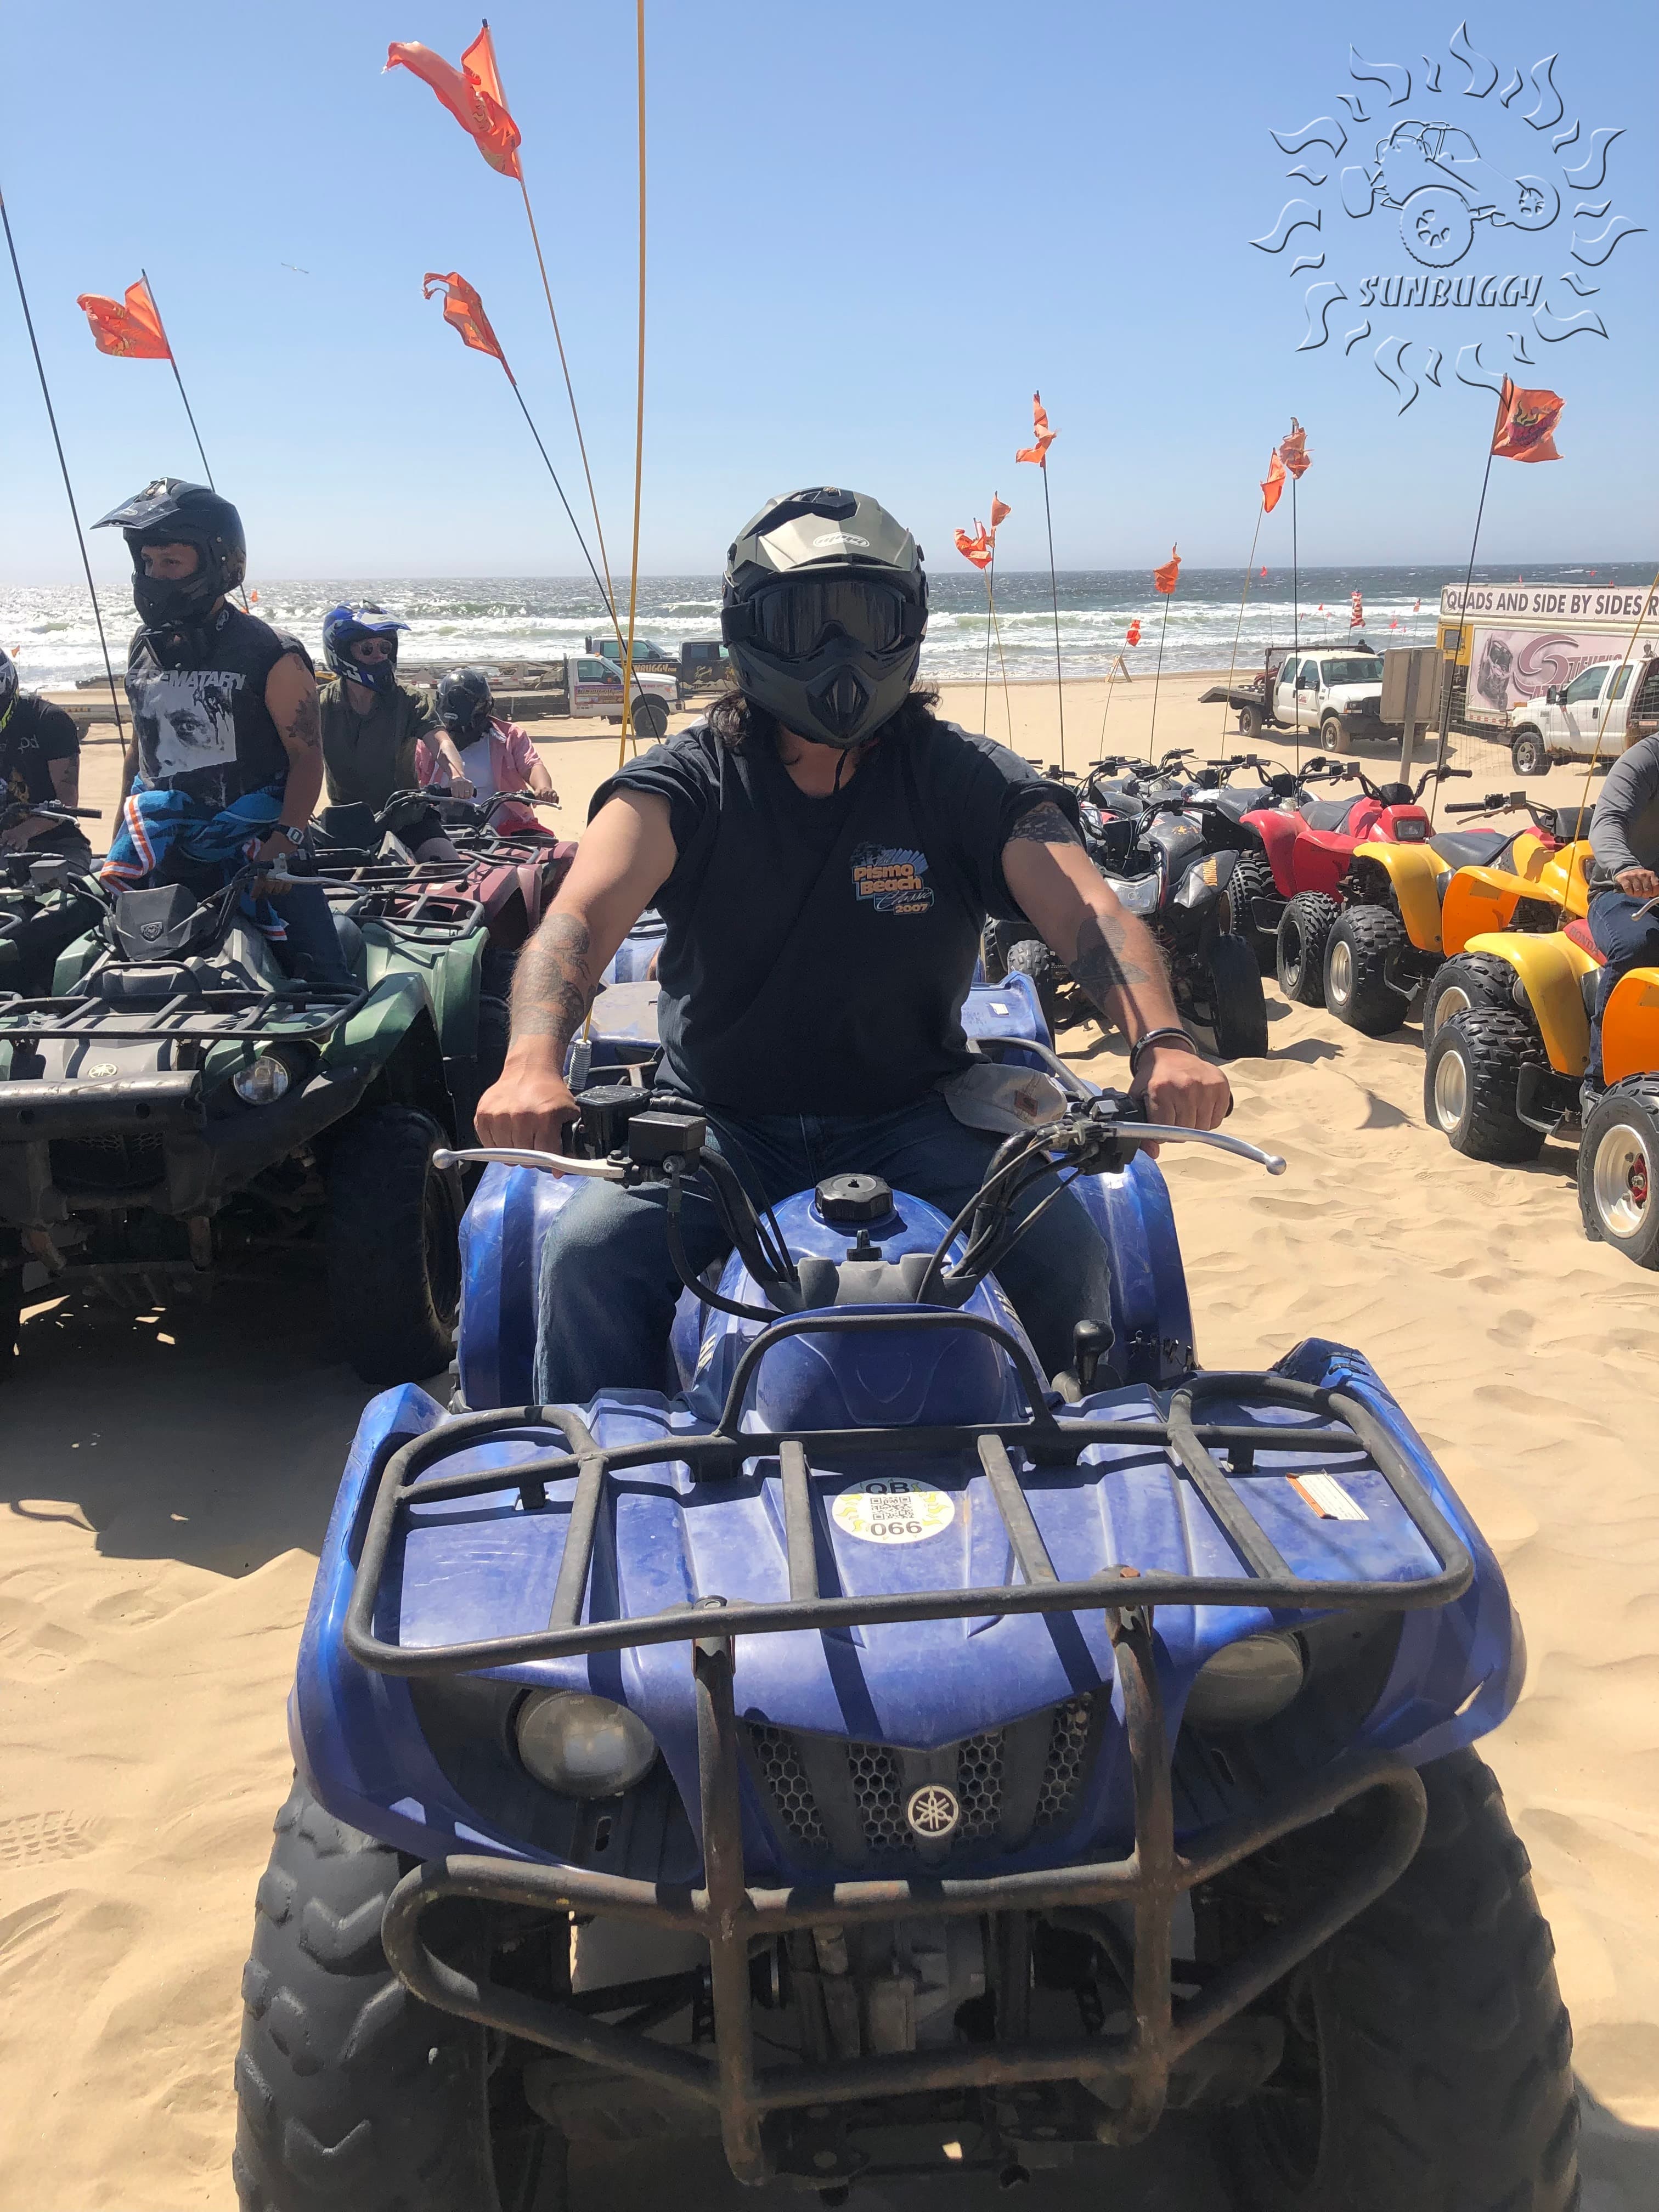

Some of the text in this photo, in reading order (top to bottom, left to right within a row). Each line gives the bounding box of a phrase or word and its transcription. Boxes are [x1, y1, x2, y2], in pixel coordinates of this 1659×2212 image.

[1447, 591, 1493, 611] QUADS
[1496, 592, 1528, 611] AND
[1532, 593, 1566, 613] SIDE
[1571, 594, 1592, 614] BY
[1595, 594, 1643, 616] SIDES
[854, 864, 914, 881] Pismo
[860, 876, 922, 895] Beach
[895, 903, 928, 913] 2007
[1569, 926, 1599, 956] HONDA
[866, 1482, 910, 1495] QB
[871, 1521, 922, 1536] 066
